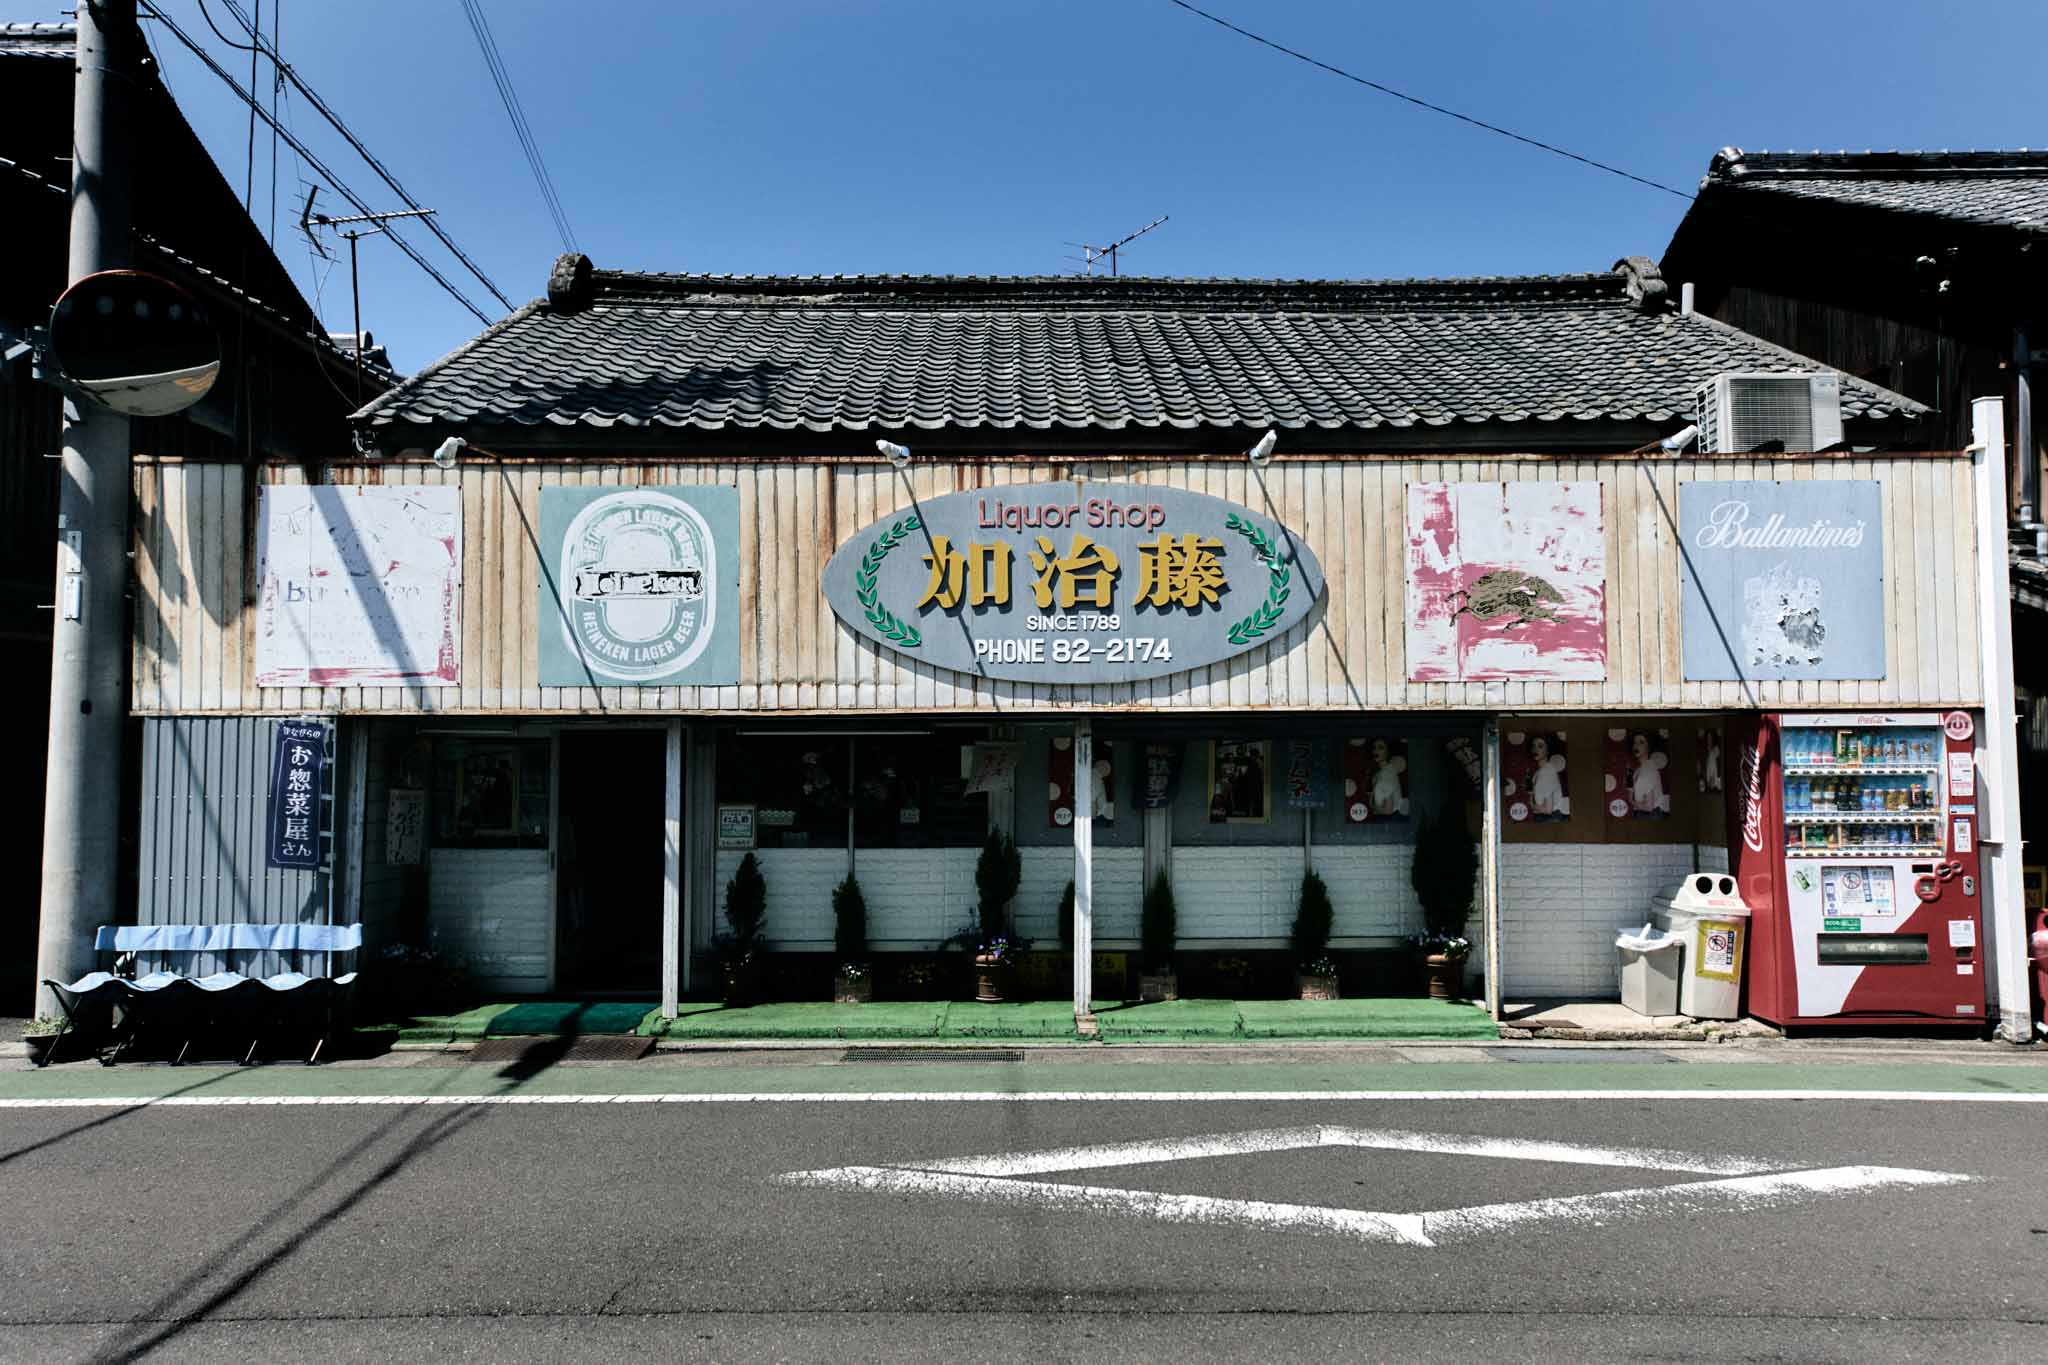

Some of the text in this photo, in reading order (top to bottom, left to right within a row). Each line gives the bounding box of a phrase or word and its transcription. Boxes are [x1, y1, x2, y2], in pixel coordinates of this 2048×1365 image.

[978, 498, 1166, 531] Liquor Shop
[1696, 500, 1866, 550] Ballantine's
[916, 532, 1231, 611] 加治藤
[583, 609, 696, 662] HEINEKEN LAGER BEER
[1026, 614, 1121, 632] SINCE 1789
[975, 637, 1173, 664] PHONE 82-2174
